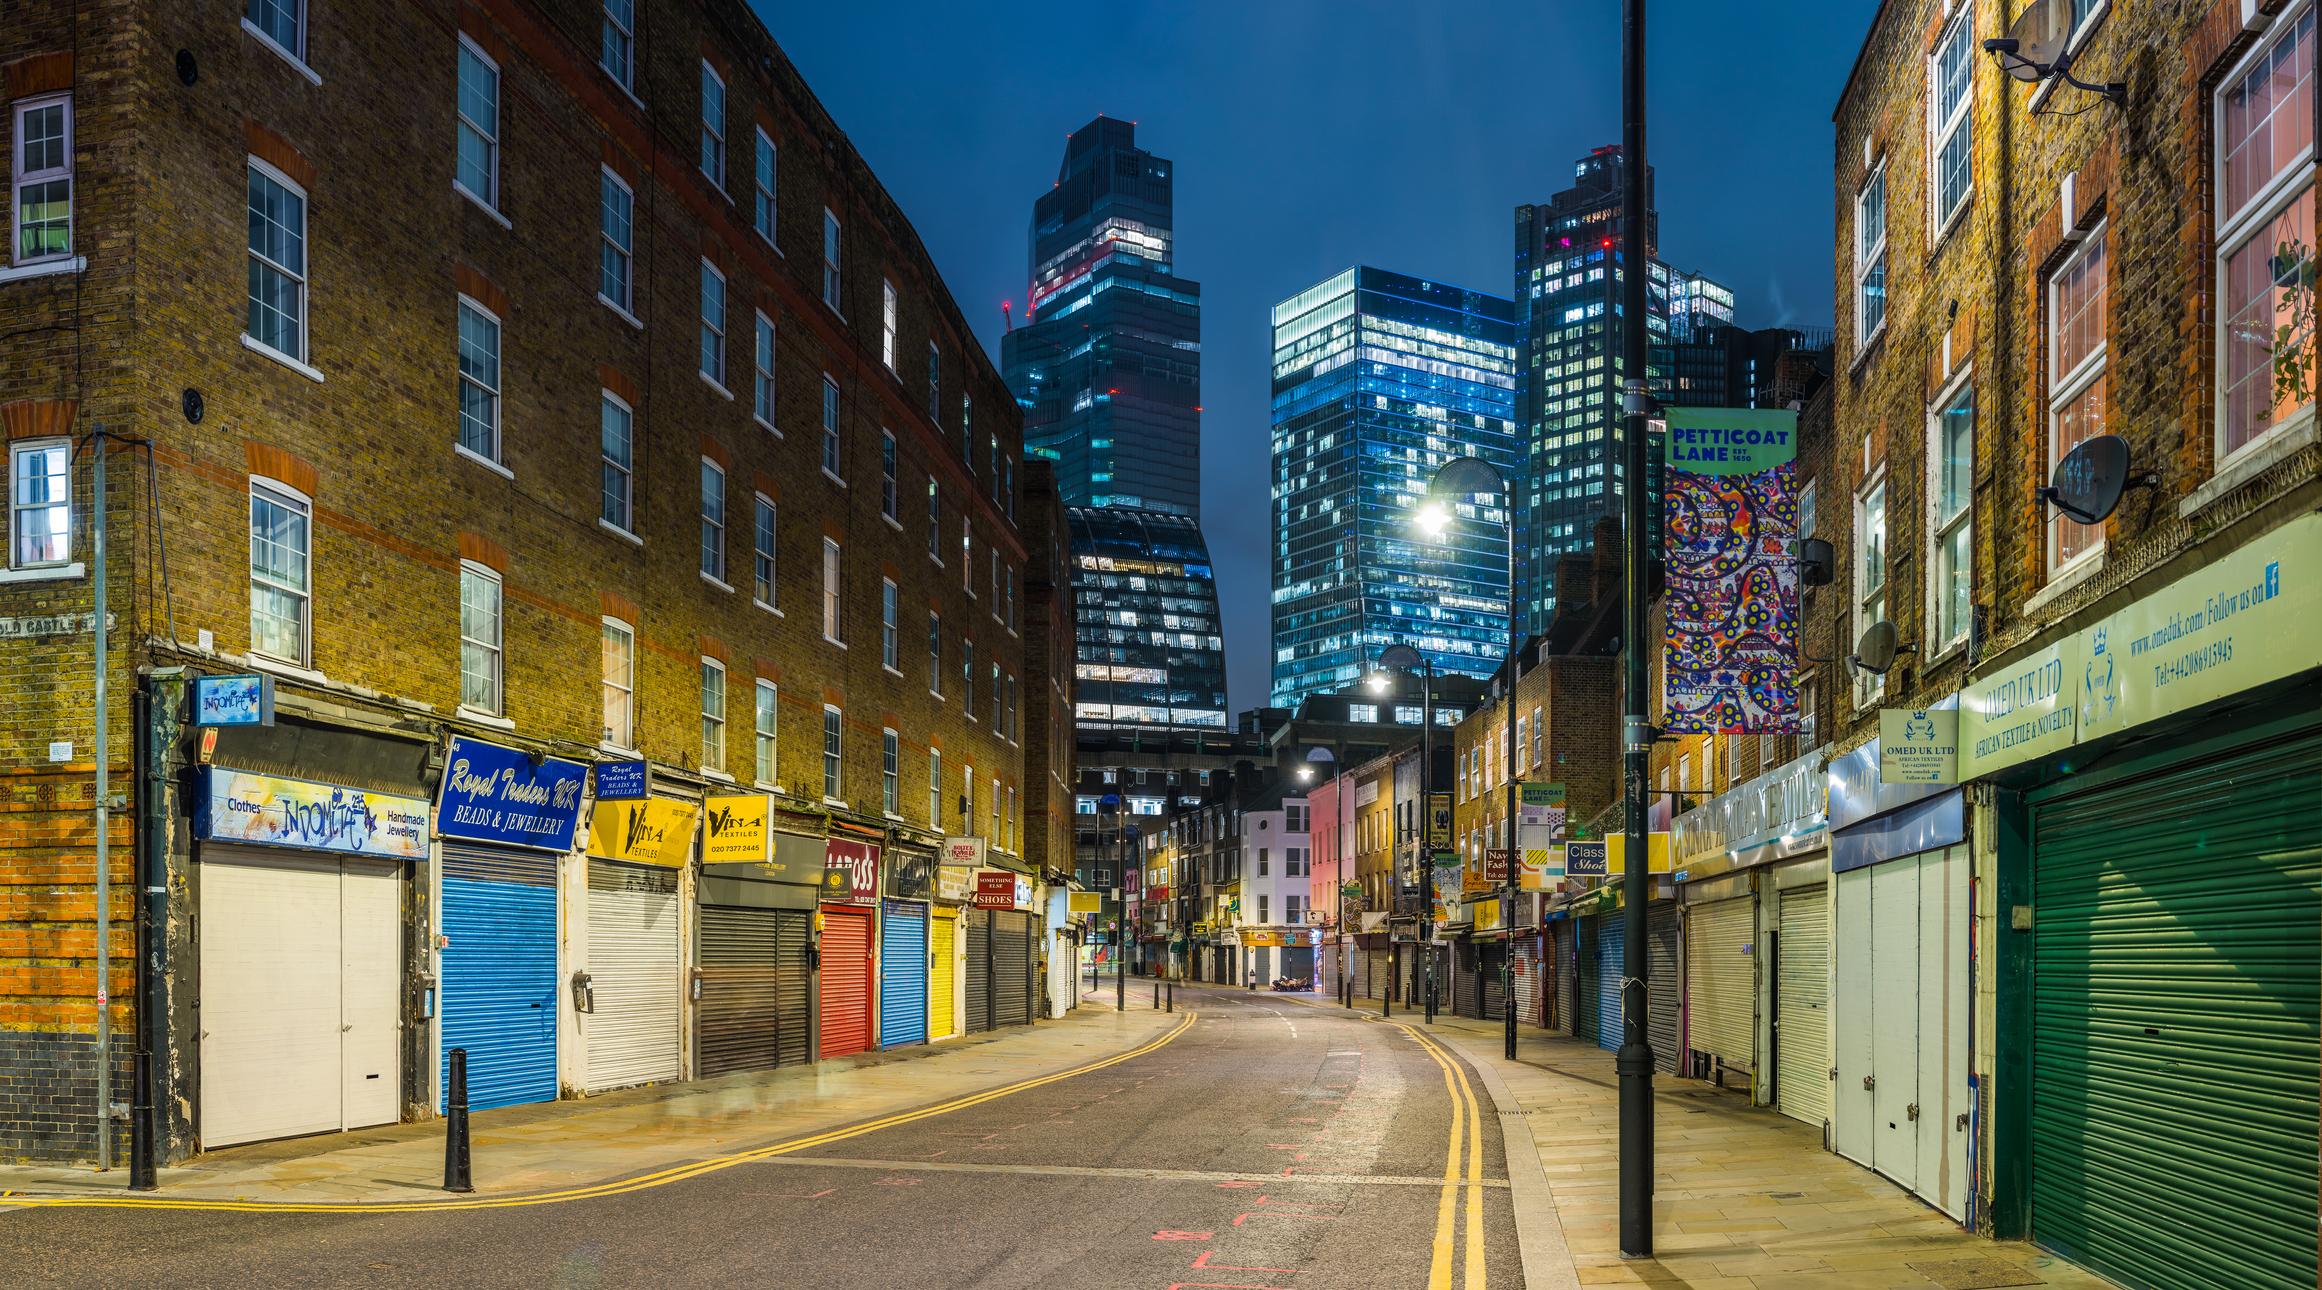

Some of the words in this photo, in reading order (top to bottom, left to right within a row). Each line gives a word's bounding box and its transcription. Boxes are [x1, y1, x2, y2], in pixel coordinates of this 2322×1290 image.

[1673, 428, 1789, 445] PETTICOAT
[1673, 445, 1729, 461] LANE
[2240, 595, 2249, 611] us
[2252, 583, 2264, 606] on
[26, 618, 74, 633] CASTLE
[1984, 680, 2016, 723] OMED
[2019, 671, 2035, 708] UK
[2038, 658, 2062, 701] LTD
[1975, 733, 2003, 759] AFRICAN
[2002, 722, 2031, 749] TEXTILE
[2032, 722, 2037, 739] &
[2038, 706, 2073, 736] NOVELTY
[1887, 746, 1917, 755] OMED
[1919, 746, 1932, 755] UK
[1935, 746, 1955, 755] LTD
[612, 766, 632, 774] Royal
[629, 772, 643, 780] UK
[448, 758, 499, 803] Royal
[501, 768, 550, 806] Traders
[553, 778, 580, 810] UK
[600, 788, 643, 797] JEWELLERY
[228, 797, 261, 814] Clothes
[387, 810, 425, 826] Handmade
[454, 805, 492, 826] BEADS
[492, 810, 501, 828] &
[501, 812, 564, 835] JEWELLERY
[387, 824, 420, 842] Jewellery
[632, 847, 658, 858] TEXTILES
[978, 895, 1012, 904] SHOES
